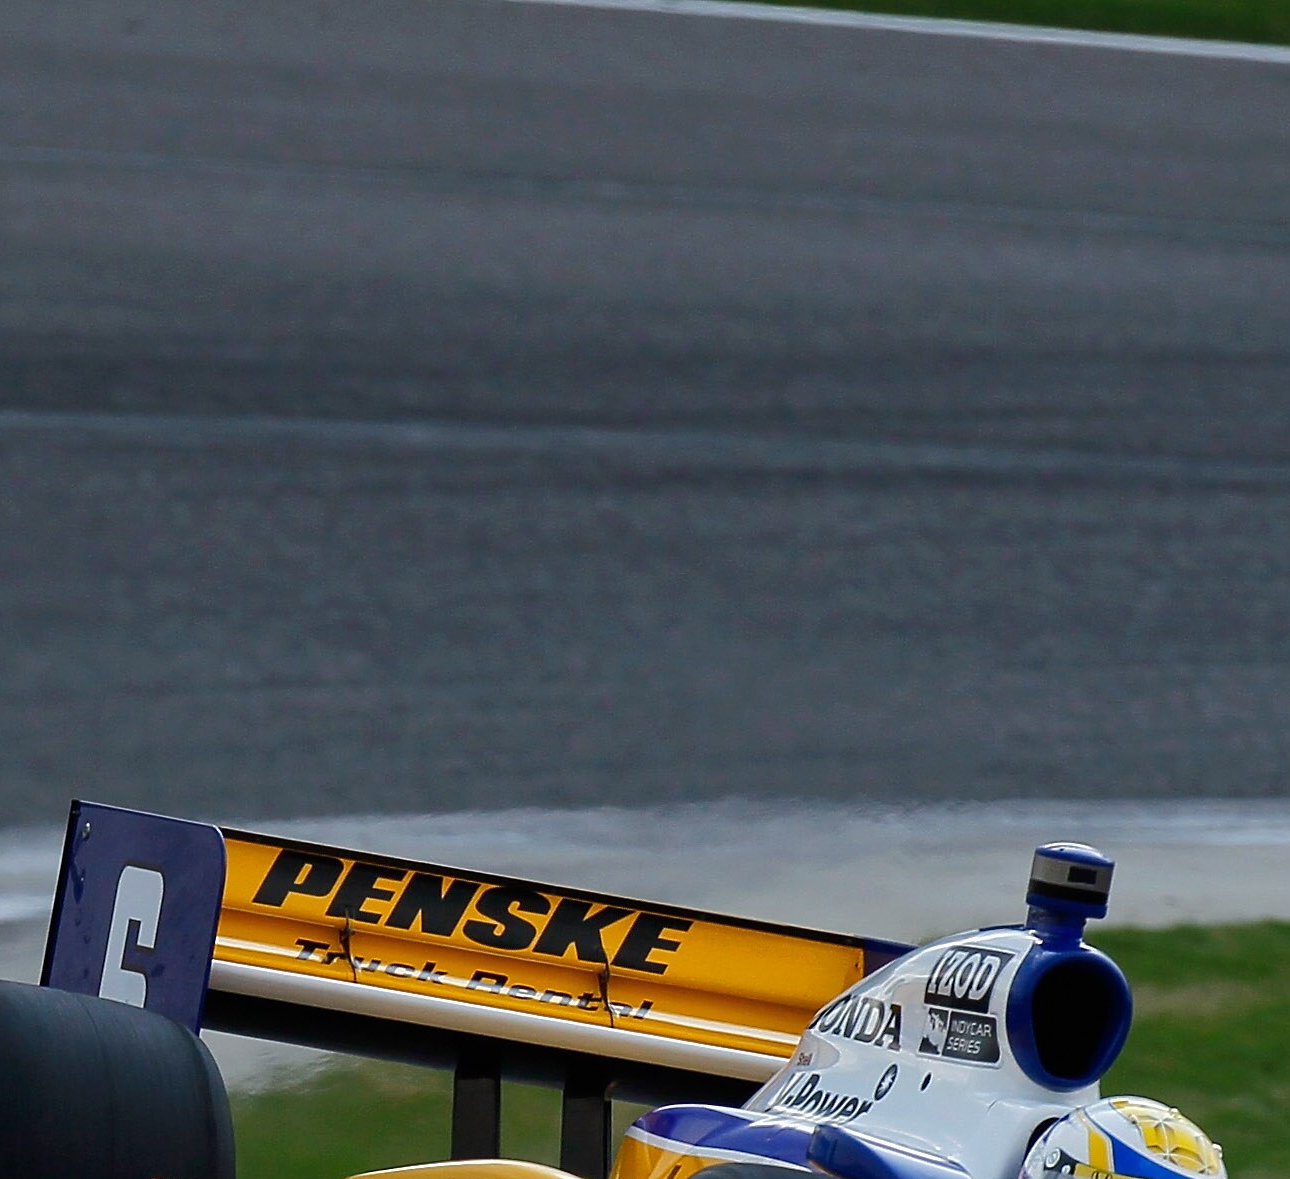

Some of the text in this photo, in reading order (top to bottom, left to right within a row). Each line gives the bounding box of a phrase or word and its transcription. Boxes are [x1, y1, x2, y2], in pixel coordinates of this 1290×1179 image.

[252, 848, 693, 976] PENSKE
[294, 938, 654, 1019] Truck Rental
[928, 950, 1001, 1000] IZOD
[808, 994, 902, 1052] ONDA
[947, 1036, 981, 1054] SERIES
[951, 1020, 992, 1037] INDYCAR
